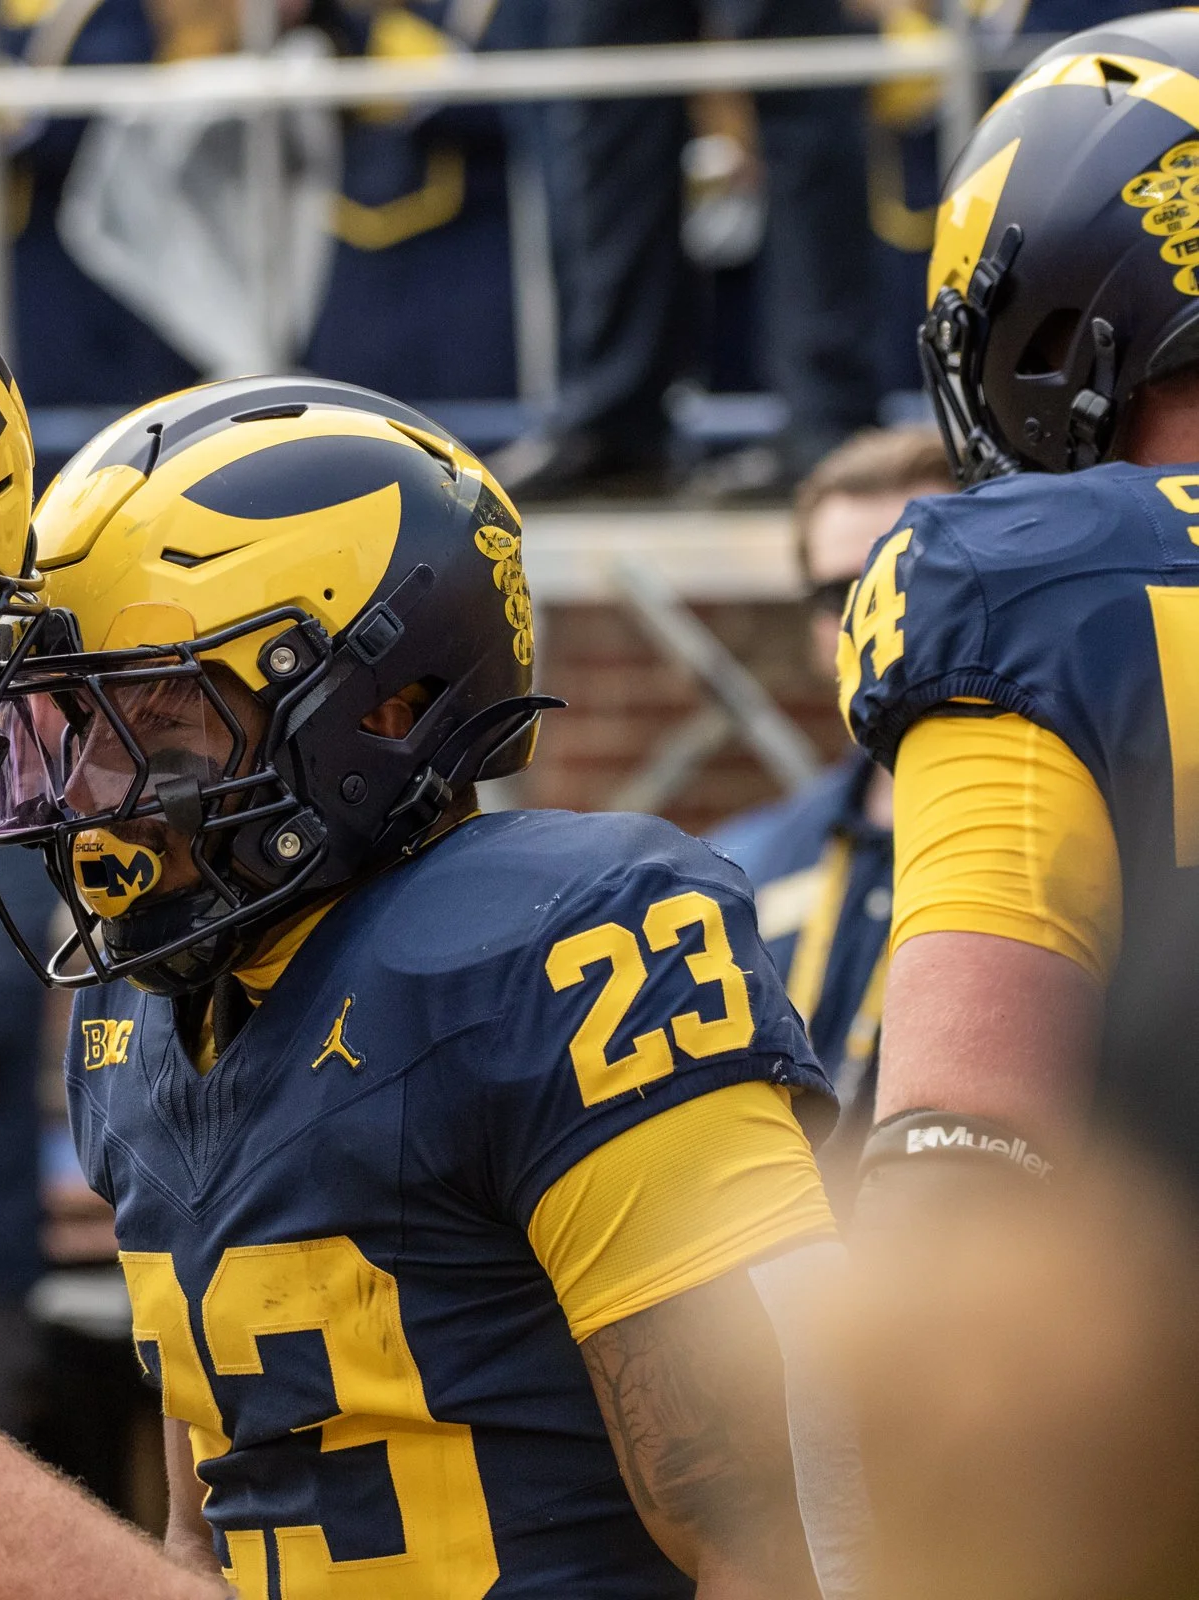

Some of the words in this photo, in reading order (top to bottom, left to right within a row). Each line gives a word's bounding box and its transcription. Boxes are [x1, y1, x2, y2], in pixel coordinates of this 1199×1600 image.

[1171, 237, 1199, 259] TE
[75, 842, 104, 853] SHOCK
[100, 850, 154, 897] M
[545, 889, 756, 1108] 23
[932, 1125, 1054, 1178] Mueller
